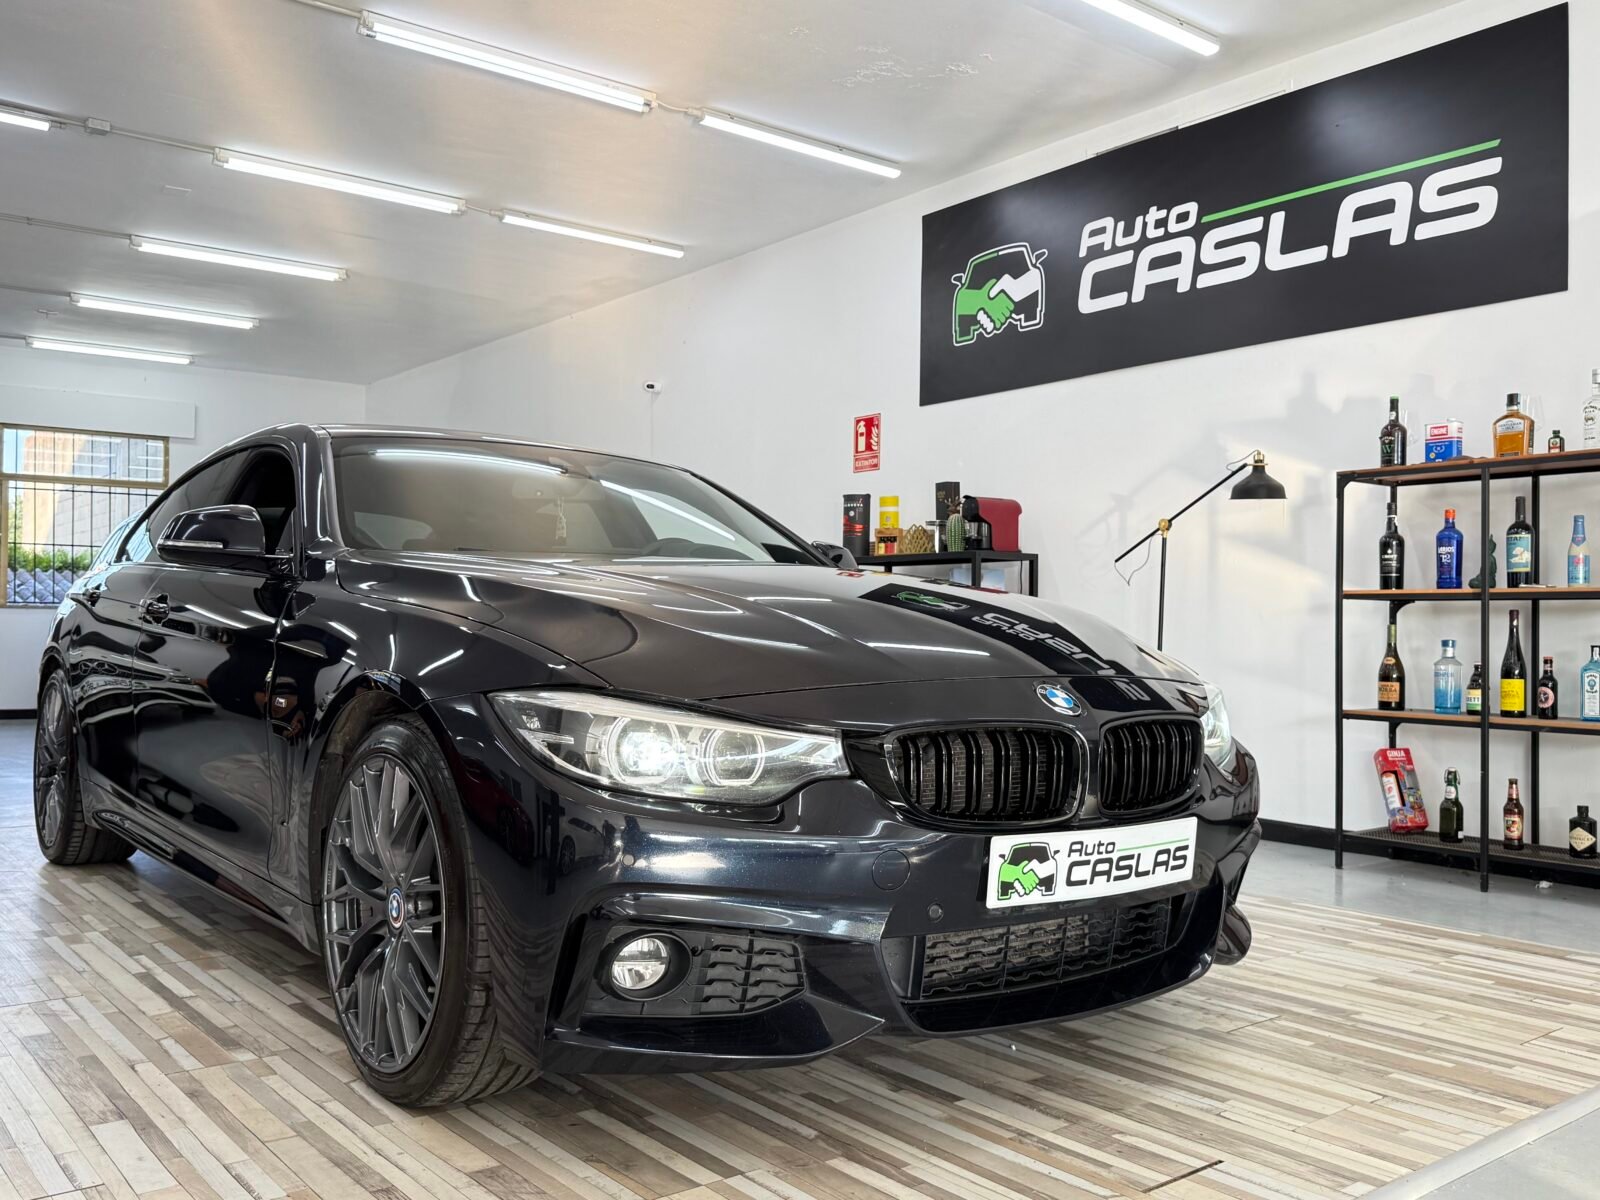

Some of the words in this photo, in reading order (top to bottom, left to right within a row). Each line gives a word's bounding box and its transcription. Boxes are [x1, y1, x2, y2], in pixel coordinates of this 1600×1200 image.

[1077, 156, 1503, 315] CASLAS
[1078, 201, 1199, 258] Auto
[1065, 844, 1190, 887] CASLAS
[1067, 840, 1116, 858] Auto
